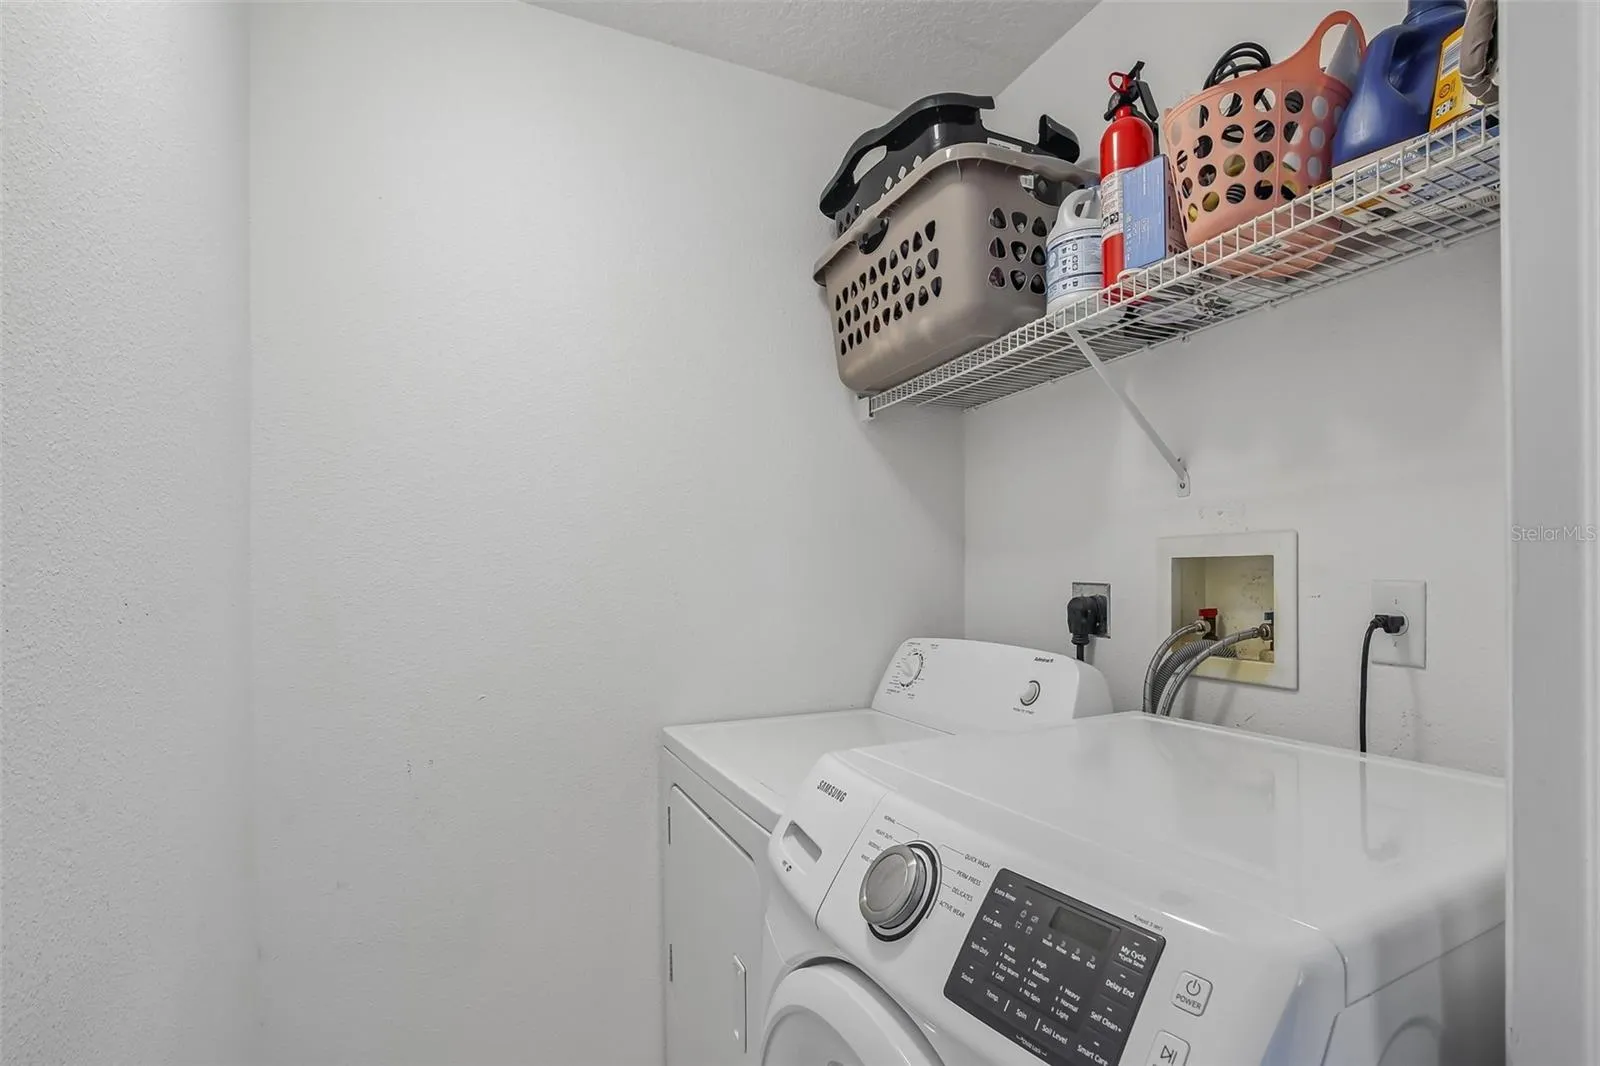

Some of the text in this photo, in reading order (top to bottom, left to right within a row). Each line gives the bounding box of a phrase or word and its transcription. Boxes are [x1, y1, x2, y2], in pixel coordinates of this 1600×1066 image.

[817, 780, 847, 802] SAMSUNG
[964, 853, 991, 869] QUICK WASH
[956, 870, 982, 887] PERM PRESS
[951, 886, 974, 902] DELICATES
[994, 887, 1006, 897] Extra
[939, 900, 966, 918] ACTIVE WEAR
[982, 914, 994, 924] Extra
[1120, 945, 1147, 963] My Cycle
[1085, 961, 1096, 970] End
[1064, 987, 1080, 1002] Heavy
[1105, 978, 1135, 999] Delay End
[1060, 997, 1079, 1013] Normal
[1175, 993, 1203, 1010] POWER
[1016, 1008, 1027, 1020] Spin
[1056, 1008, 1069, 1021] Light
[1090, 1011, 1103, 1022] Self
[1041, 1024, 1069, 1045] Soil Level
[1077, 1044, 1109, 1066] Smart Care
